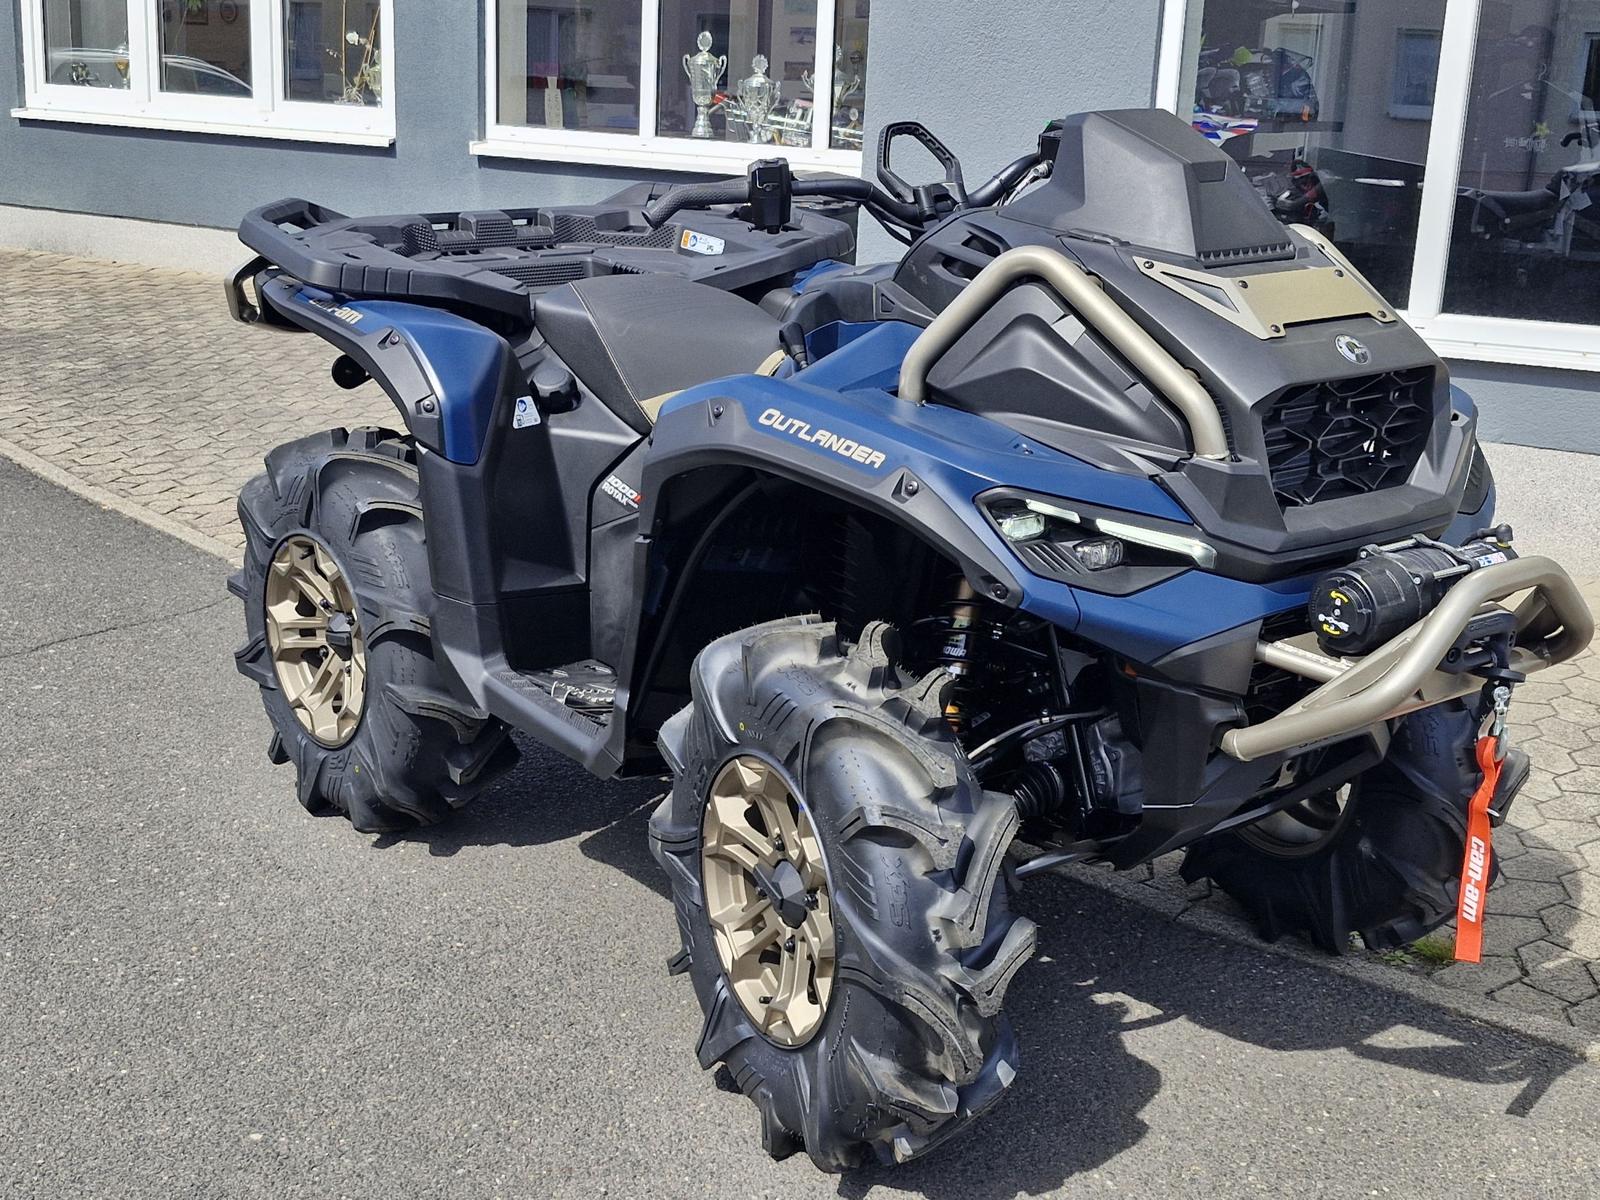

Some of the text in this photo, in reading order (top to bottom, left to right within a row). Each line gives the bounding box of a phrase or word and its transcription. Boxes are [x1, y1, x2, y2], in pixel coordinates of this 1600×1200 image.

[758, 408, 886, 469] OUTLANDER
[601, 481, 628, 506] ROTAX
[1462, 835, 1485, 923] can-am
